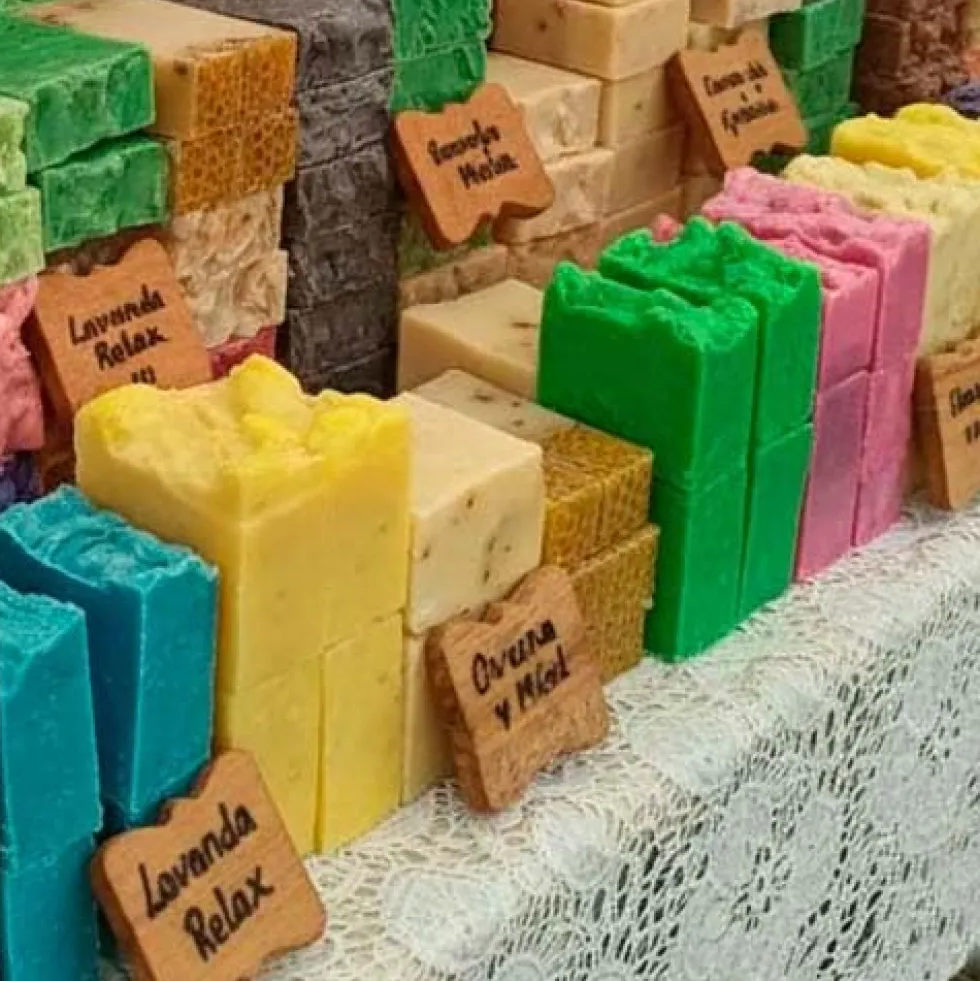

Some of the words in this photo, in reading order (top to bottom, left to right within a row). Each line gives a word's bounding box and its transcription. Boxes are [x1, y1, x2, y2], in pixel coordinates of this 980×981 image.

[68, 283, 166, 345] Lavanda
[94, 326, 170, 370] Relax
[138, 801, 258, 920] Lavanda
[183, 865, 275, 963] Relax
